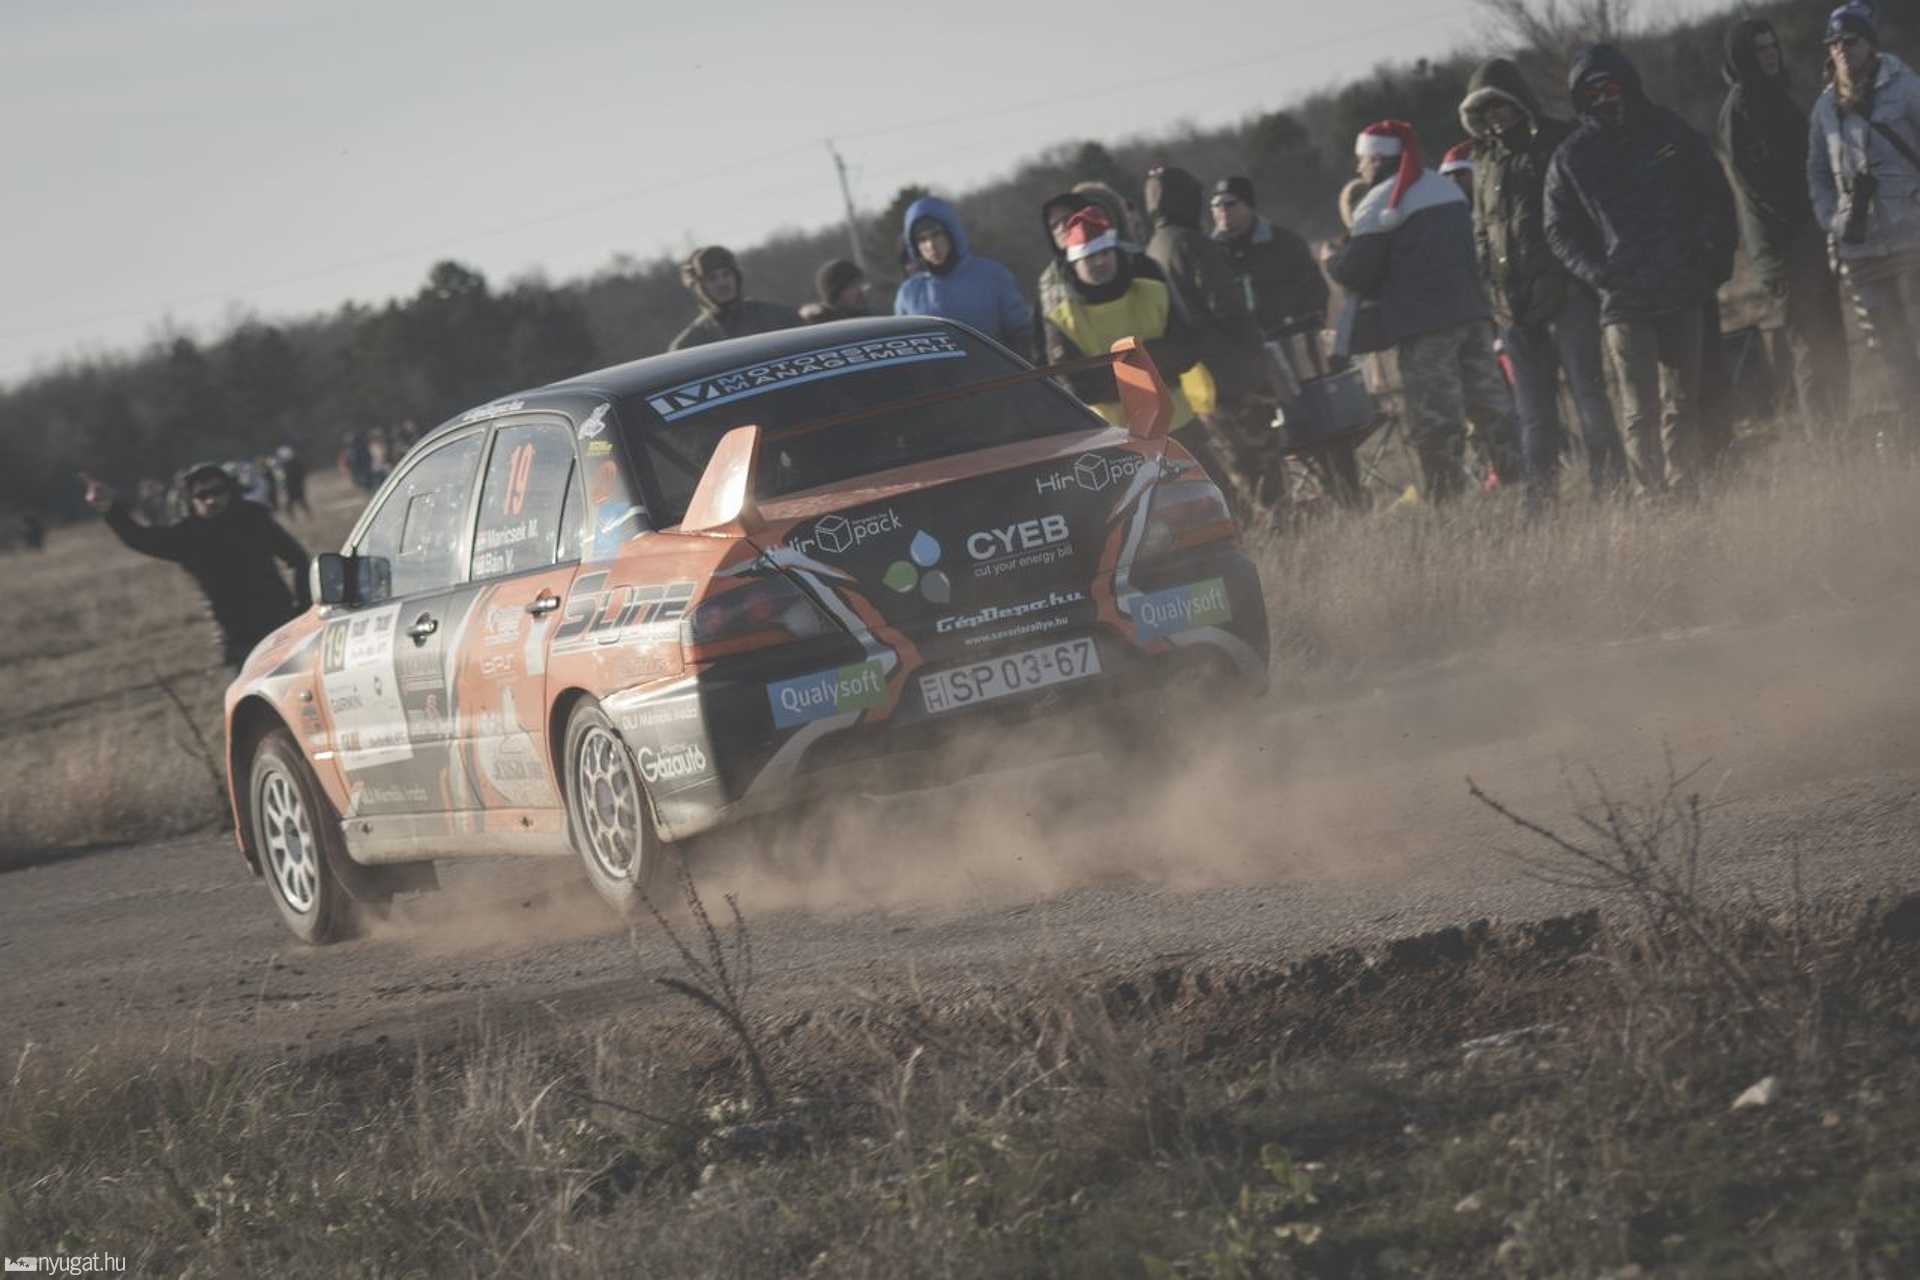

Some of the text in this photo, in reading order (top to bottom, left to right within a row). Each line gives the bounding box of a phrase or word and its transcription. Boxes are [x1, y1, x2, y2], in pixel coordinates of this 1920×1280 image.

[716, 335, 950, 387] MOTORSPORT
[722, 343, 958, 393] MANAGEMENT
[853, 507, 903, 545] pack
[967, 514, 1070, 560] CYEB
[974, 564, 992, 577] cut
[993, 558, 1017, 576] your
[1019, 550, 1055, 565] energy
[1140, 587, 1226, 629] Qualysoft
[780, 670, 882, 714] Qualysoft
[950, 665, 995, 702] SP
